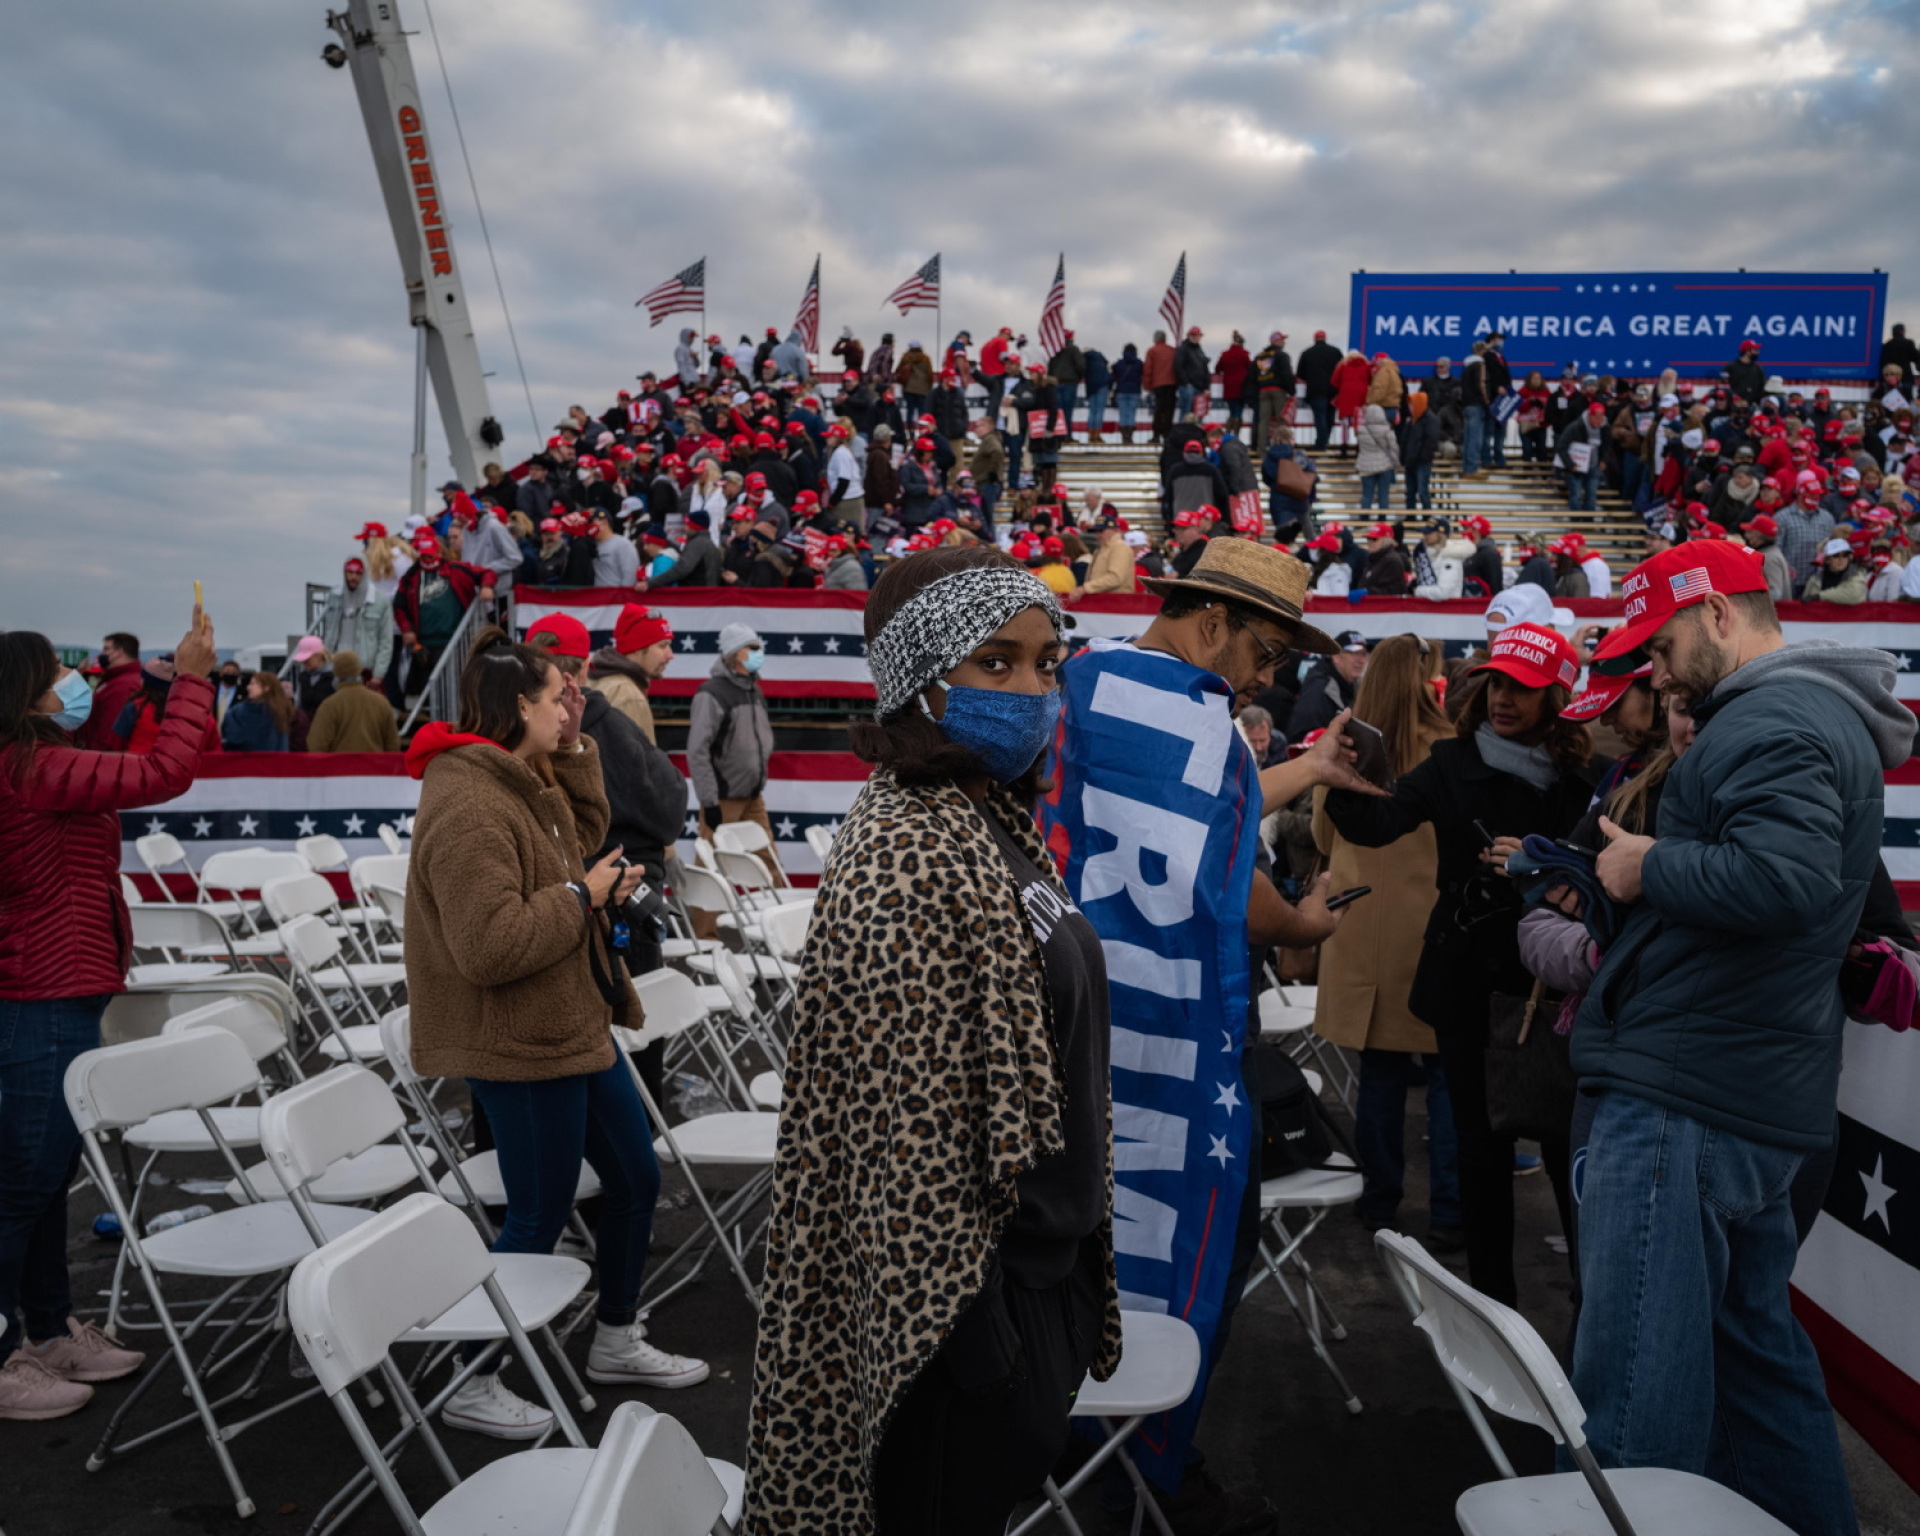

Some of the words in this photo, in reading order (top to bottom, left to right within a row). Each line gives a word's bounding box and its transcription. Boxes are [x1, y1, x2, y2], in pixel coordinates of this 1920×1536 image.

[398, 105, 453, 277] GREINER
[1375, 315, 1461, 336] MAKE
[1473, 315, 1616, 337] AMERICA
[1629, 315, 1732, 336] GREAT
[1743, 315, 1857, 337] AGAIN!
[1512, 628, 1558, 655] AMERICA
[1513, 645, 1547, 666] AGAIN
[1081, 670, 1234, 1314] TRUM
